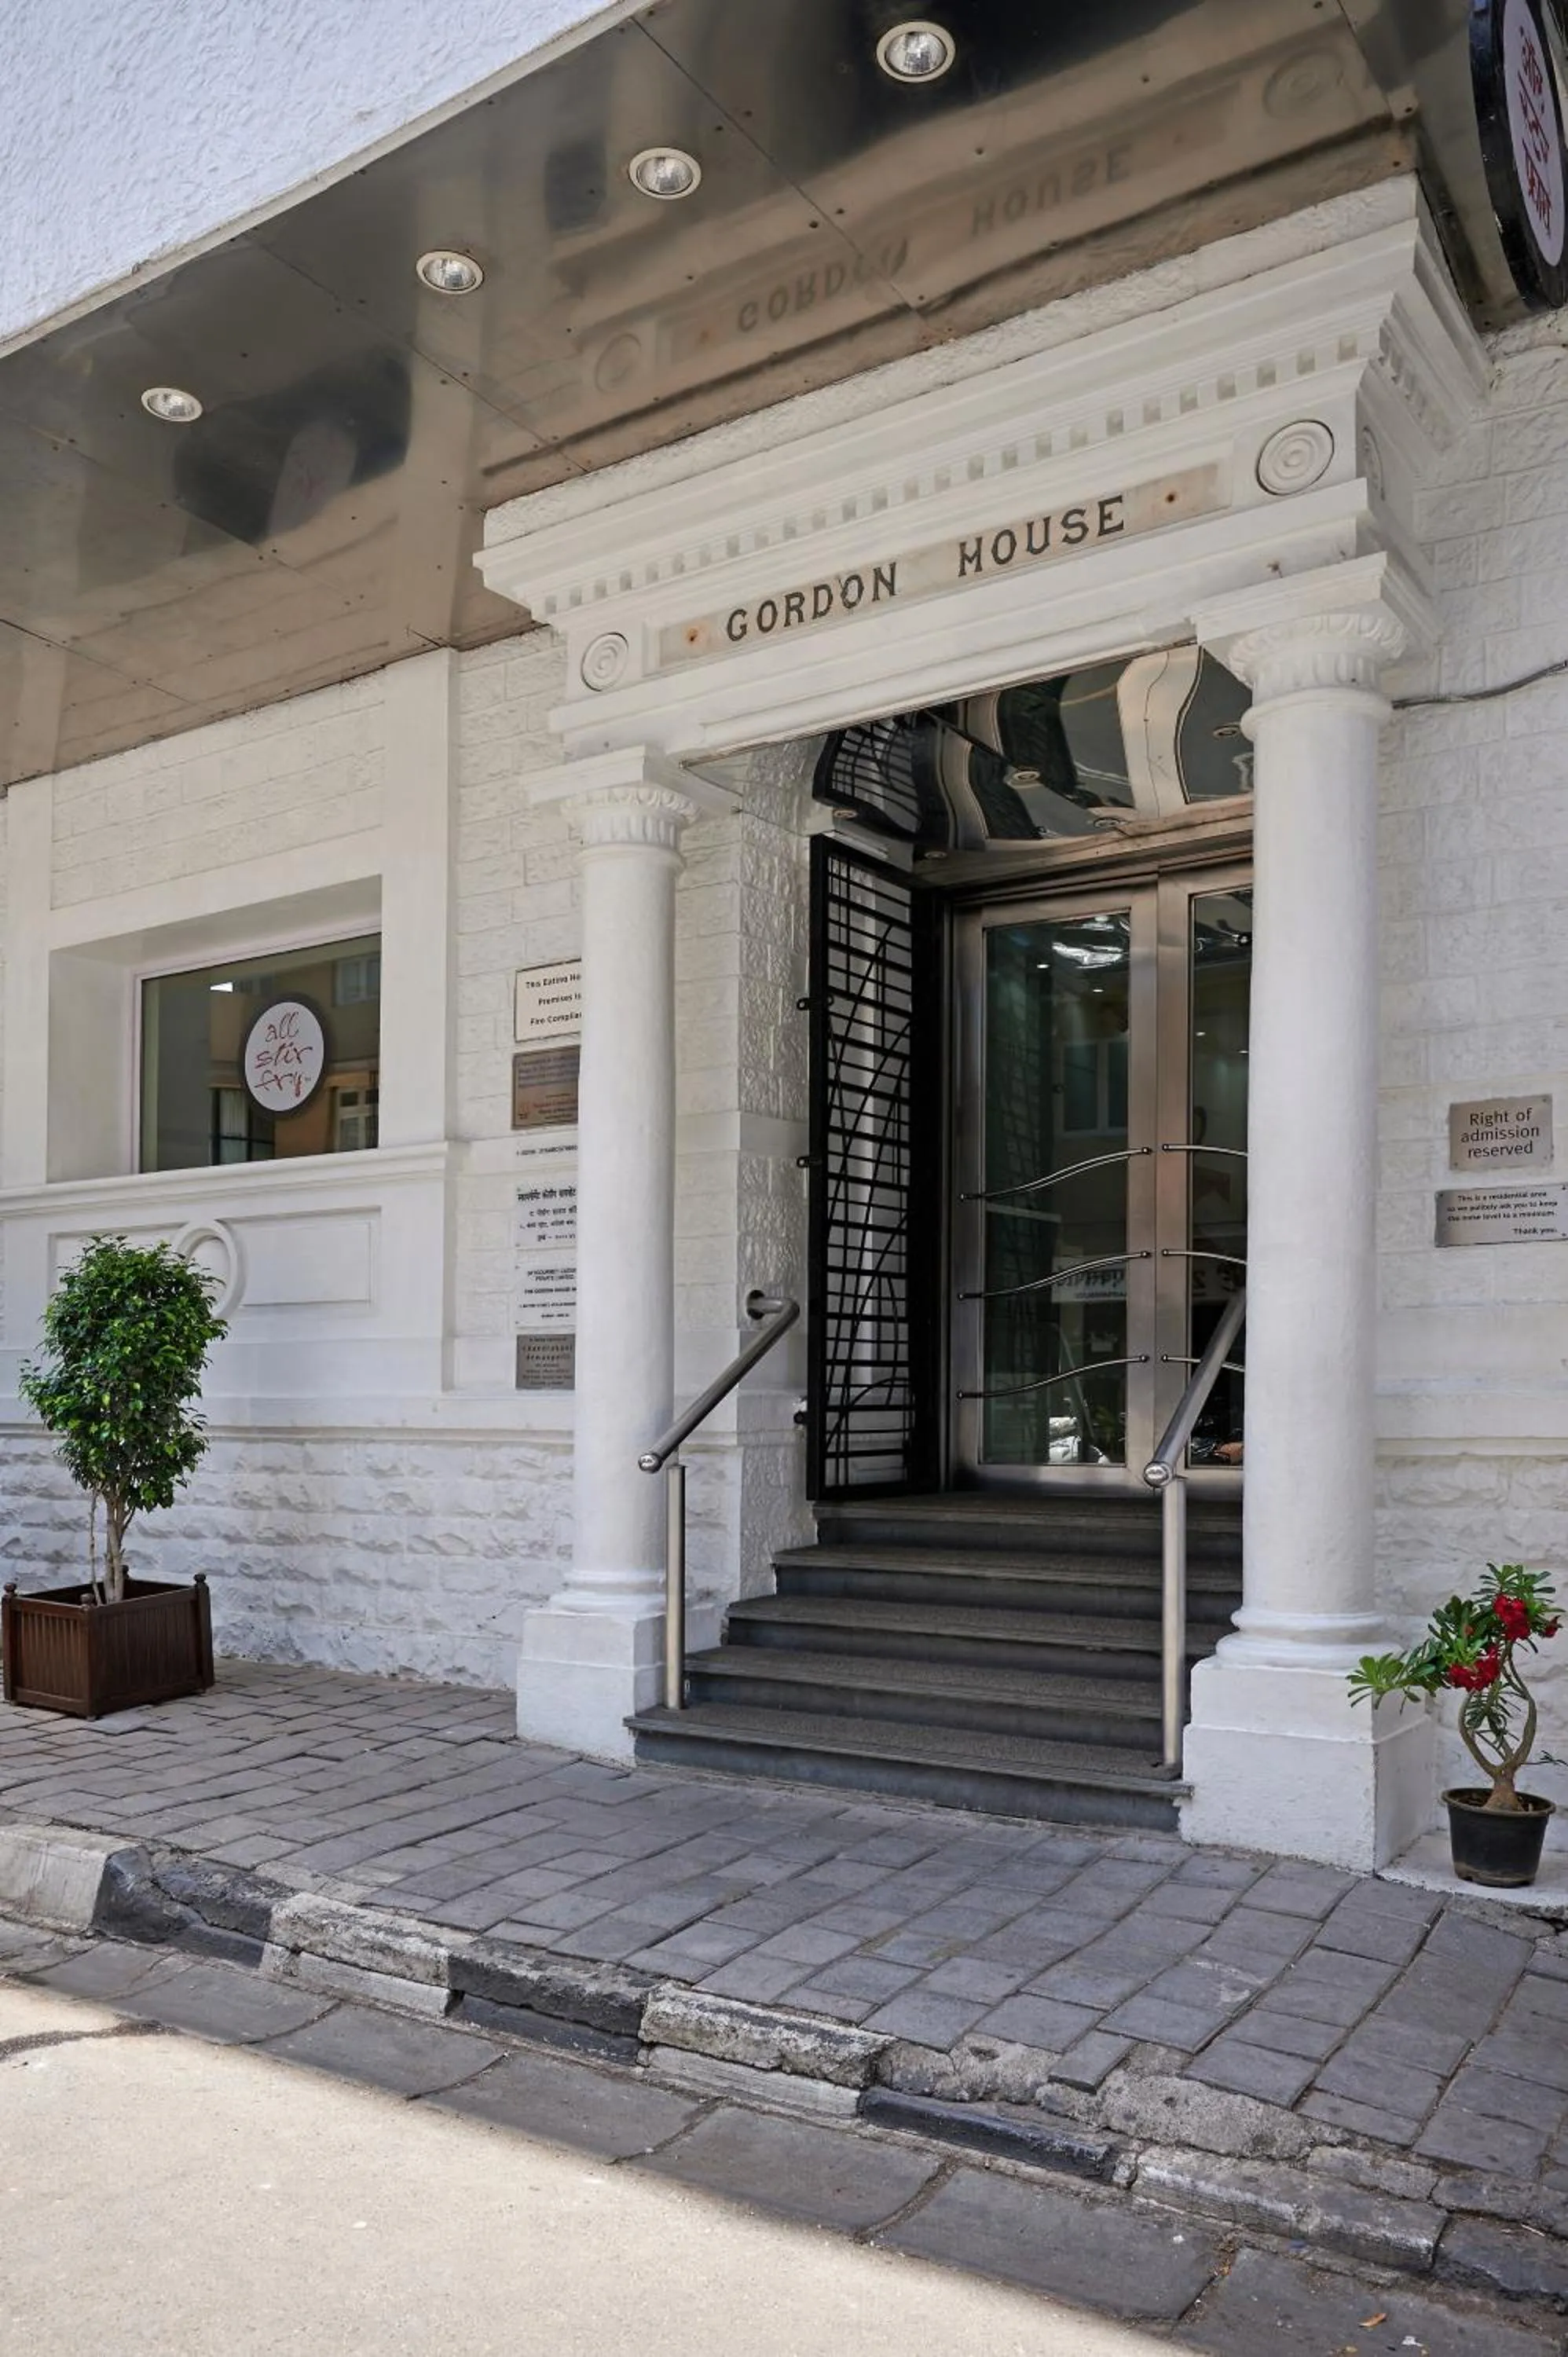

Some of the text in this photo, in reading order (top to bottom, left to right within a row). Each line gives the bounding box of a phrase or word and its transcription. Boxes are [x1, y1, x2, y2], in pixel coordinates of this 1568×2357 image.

[727, 495, 1124, 642] GORDON HOUSE
[265, 1011, 299, 1043] all
[255, 1042, 313, 1069] stir
[255, 1069, 302, 1098] fry
[1470, 1108, 1533, 1127] Right of
[1460, 1124, 1540, 1143] admission
[1467, 1141, 1533, 1159] reserved
